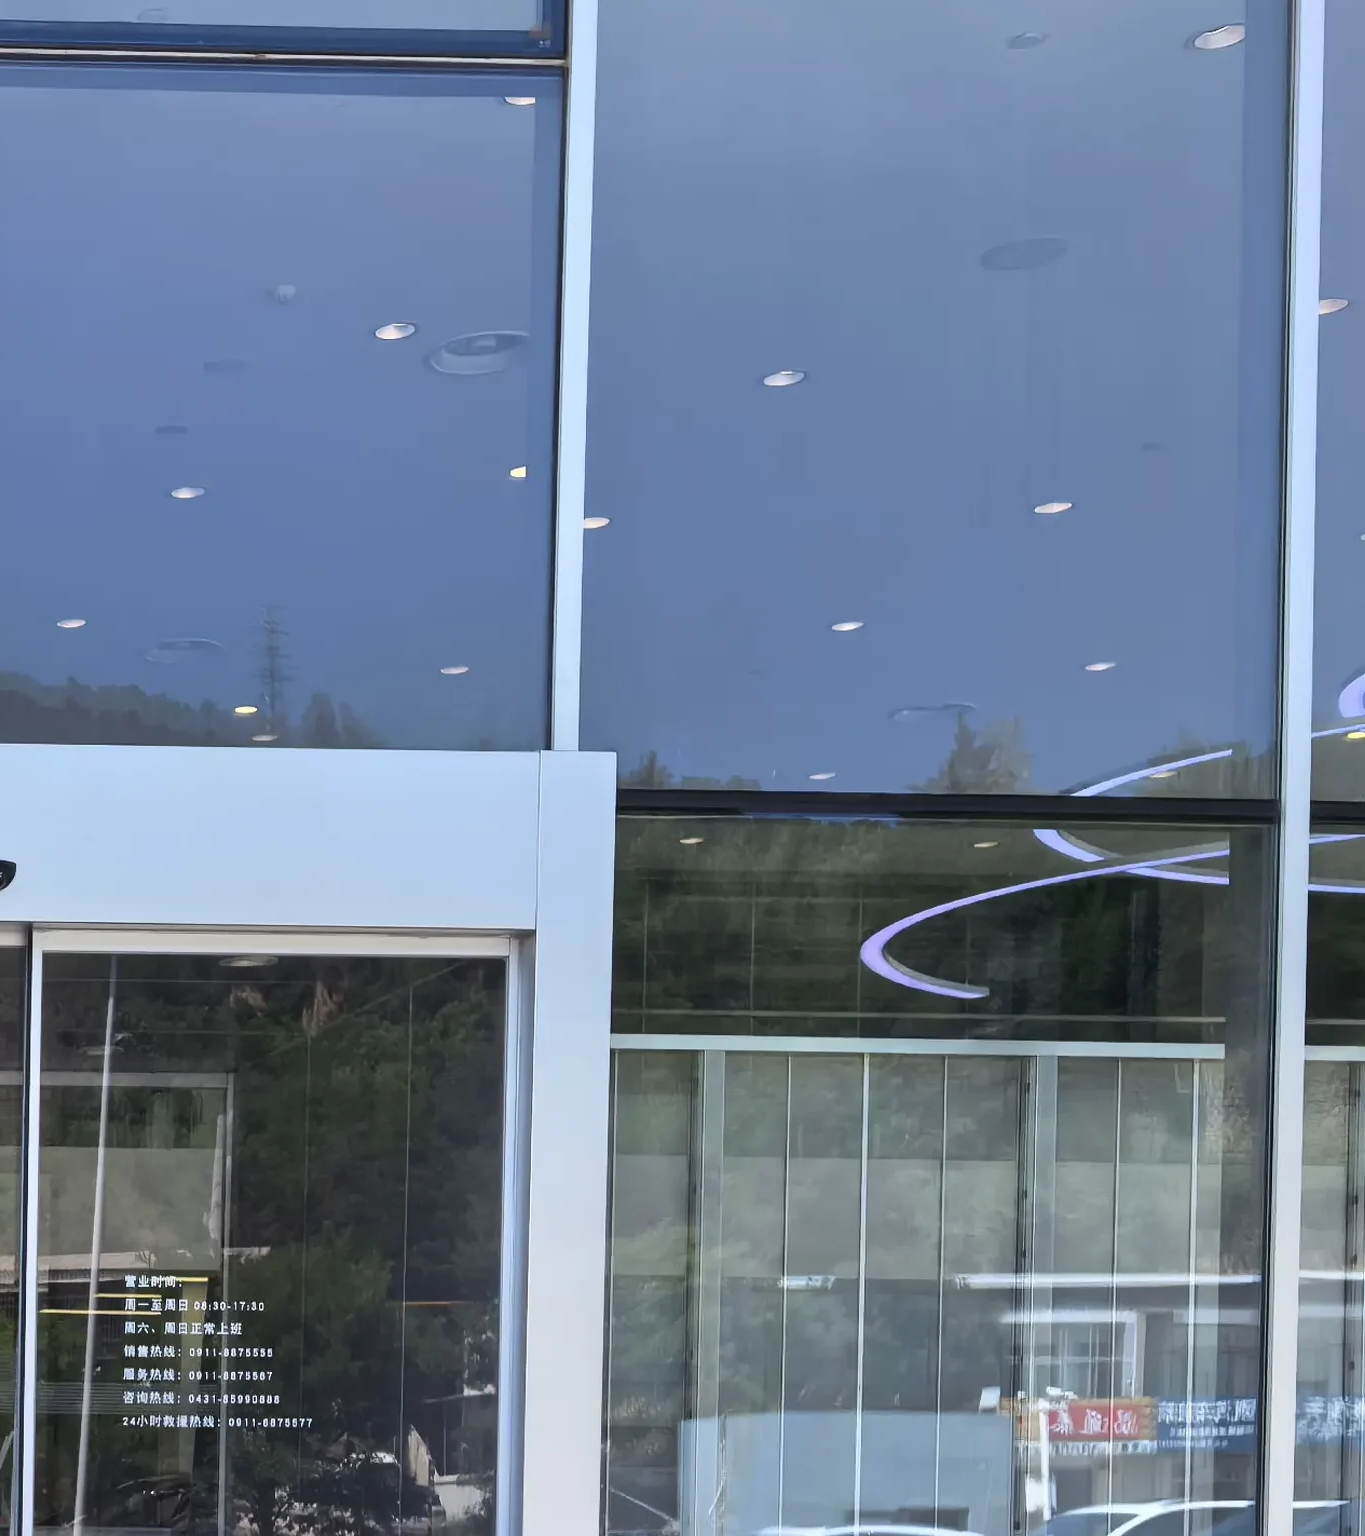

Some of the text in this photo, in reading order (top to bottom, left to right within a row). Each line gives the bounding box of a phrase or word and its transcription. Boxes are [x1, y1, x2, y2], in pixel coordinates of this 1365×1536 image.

[124, 1299, 265, 1312] 周一至周日 08:30-17:30
[124, 1322, 243, 1335] 周六、周日正常上班
